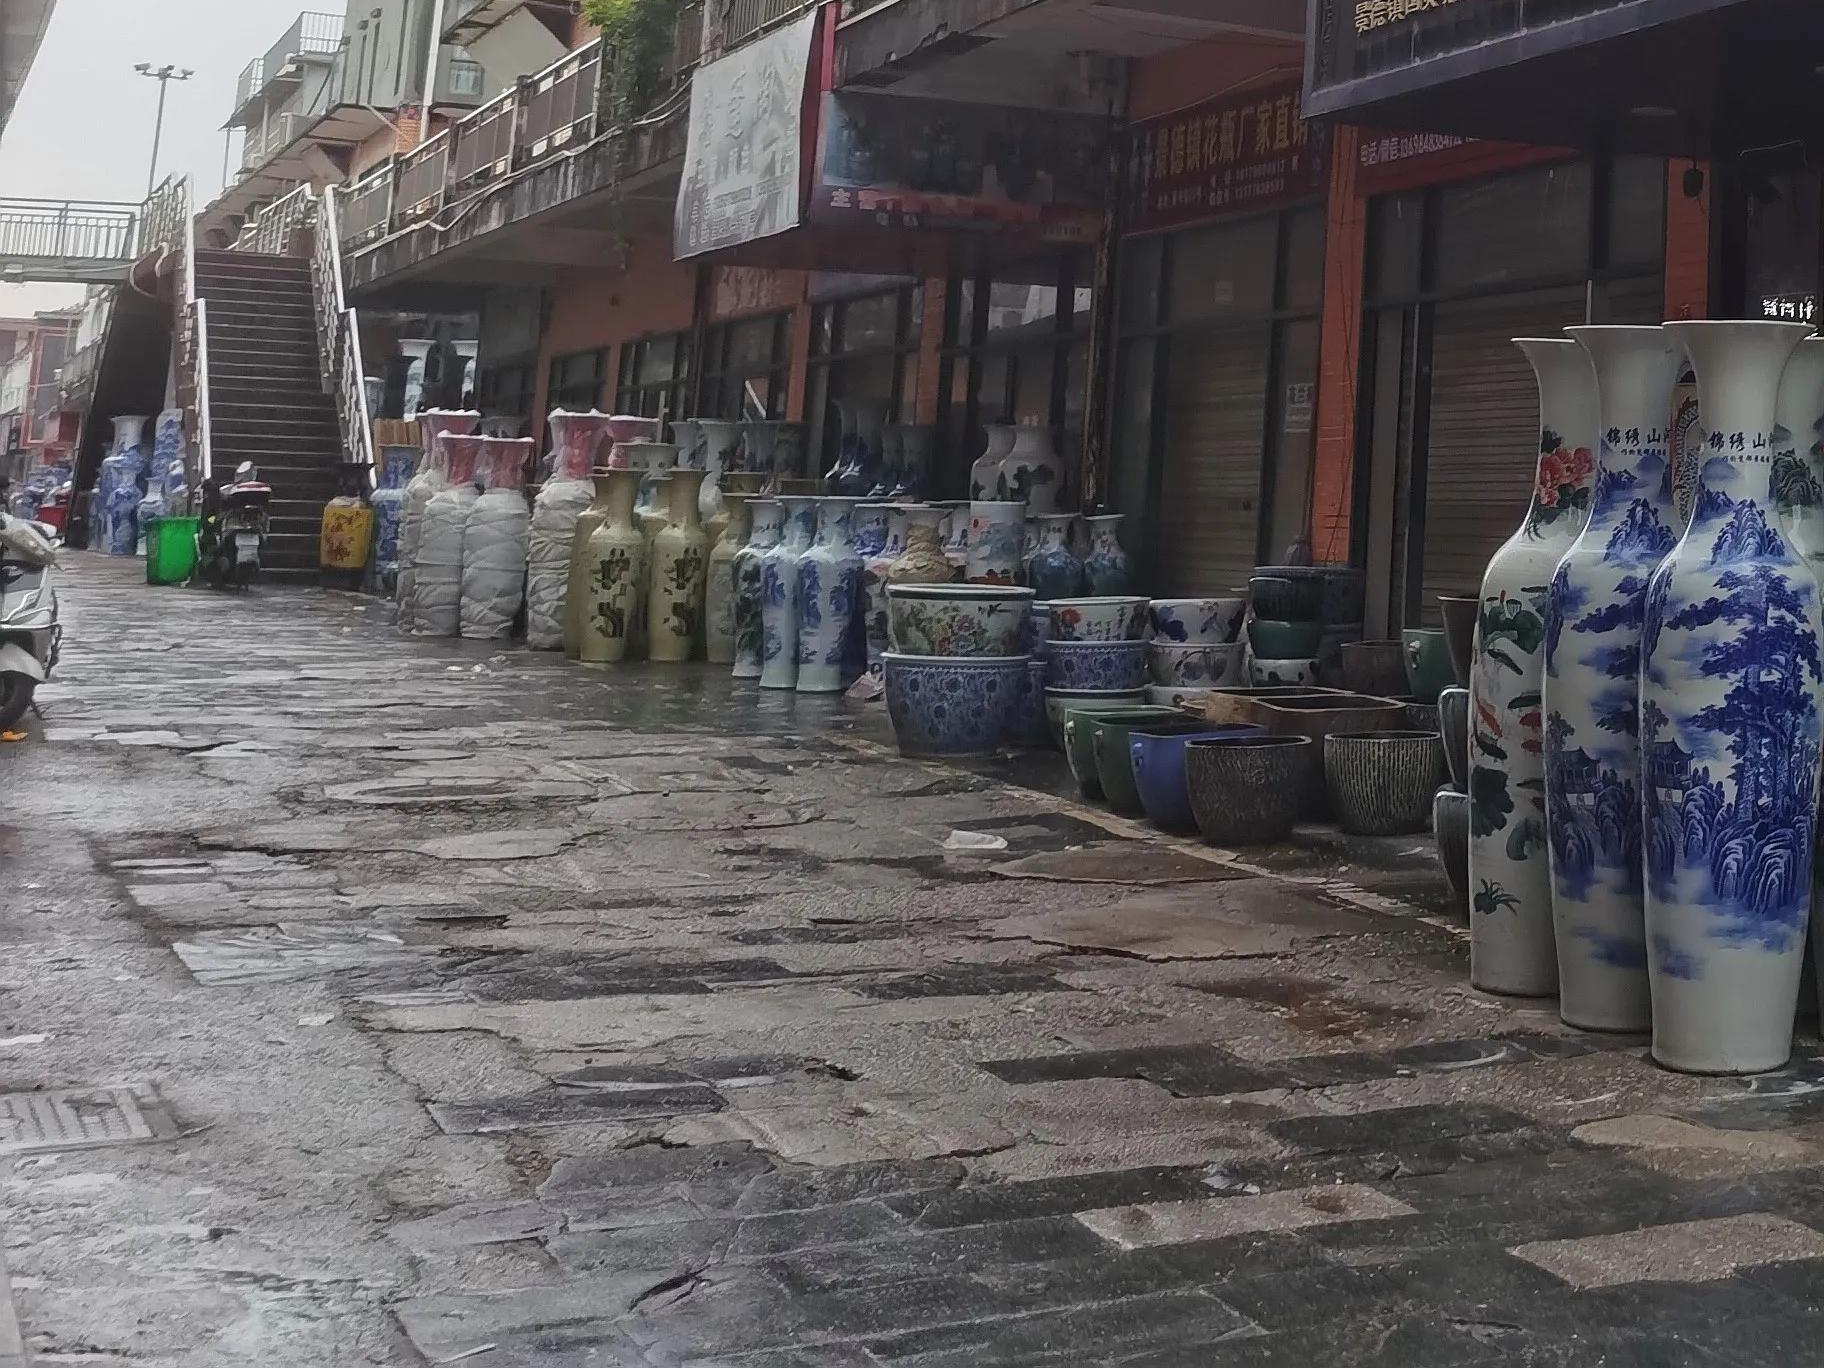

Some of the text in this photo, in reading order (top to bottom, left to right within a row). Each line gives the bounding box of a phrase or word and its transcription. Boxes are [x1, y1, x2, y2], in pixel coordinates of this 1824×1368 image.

[1606, 427, 1670, 447] 锦绣山
[1708, 431, 1773, 452] 锦绣山
